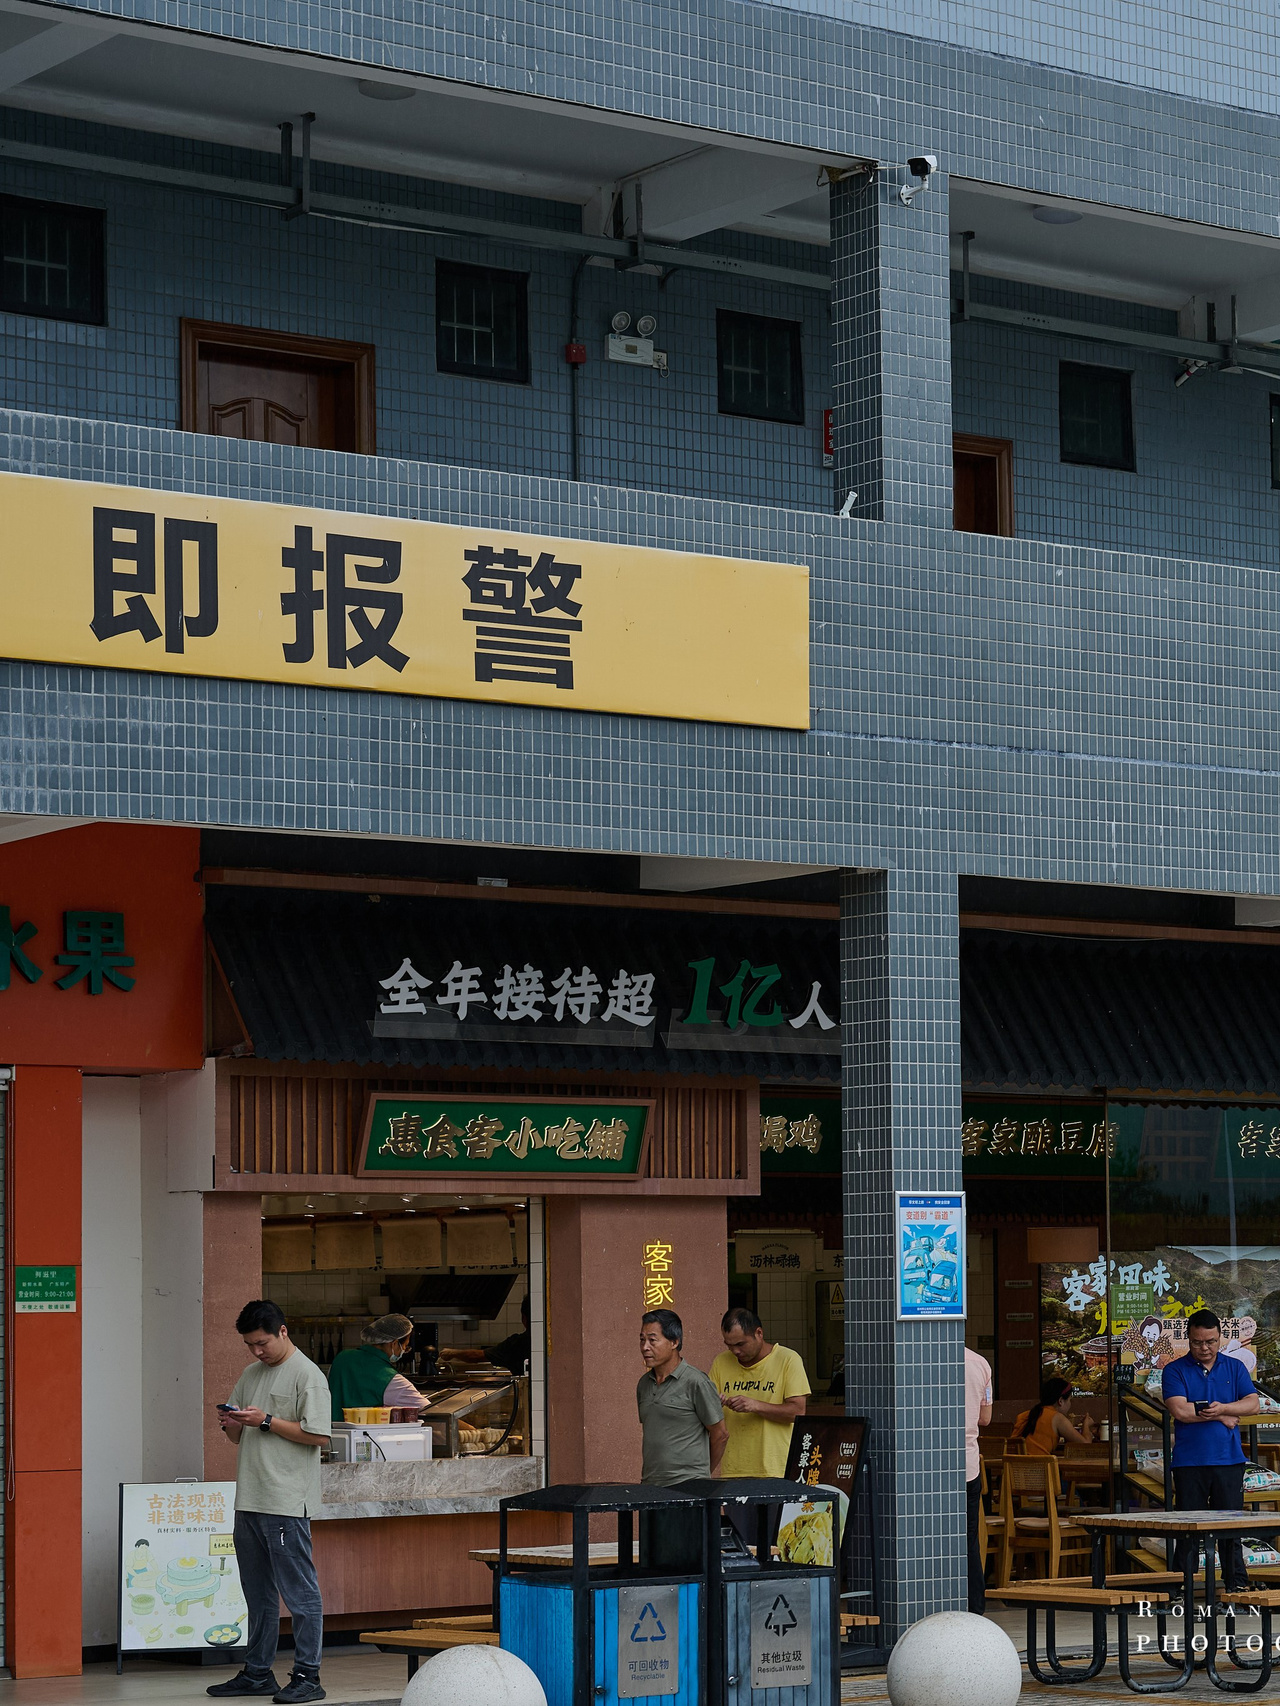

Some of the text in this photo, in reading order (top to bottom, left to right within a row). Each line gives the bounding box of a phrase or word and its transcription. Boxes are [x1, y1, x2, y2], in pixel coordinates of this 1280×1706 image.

[90, 506, 583, 690] 即报警
[379, 957, 841, 1030] 全年接待超1亿人
[1118, 1292, 1147, 1301] 营业时间
[724, 1381, 730, 1393] A
[795, 1433, 812, 1485] 客家人
[146, 1492, 226, 1509] 古法现煎
[147, 1508, 226, 1525] 非遗味道
[628, 1659, 670, 1673] 可回收物
[761, 1651, 802, 1664] 其他垃圾
